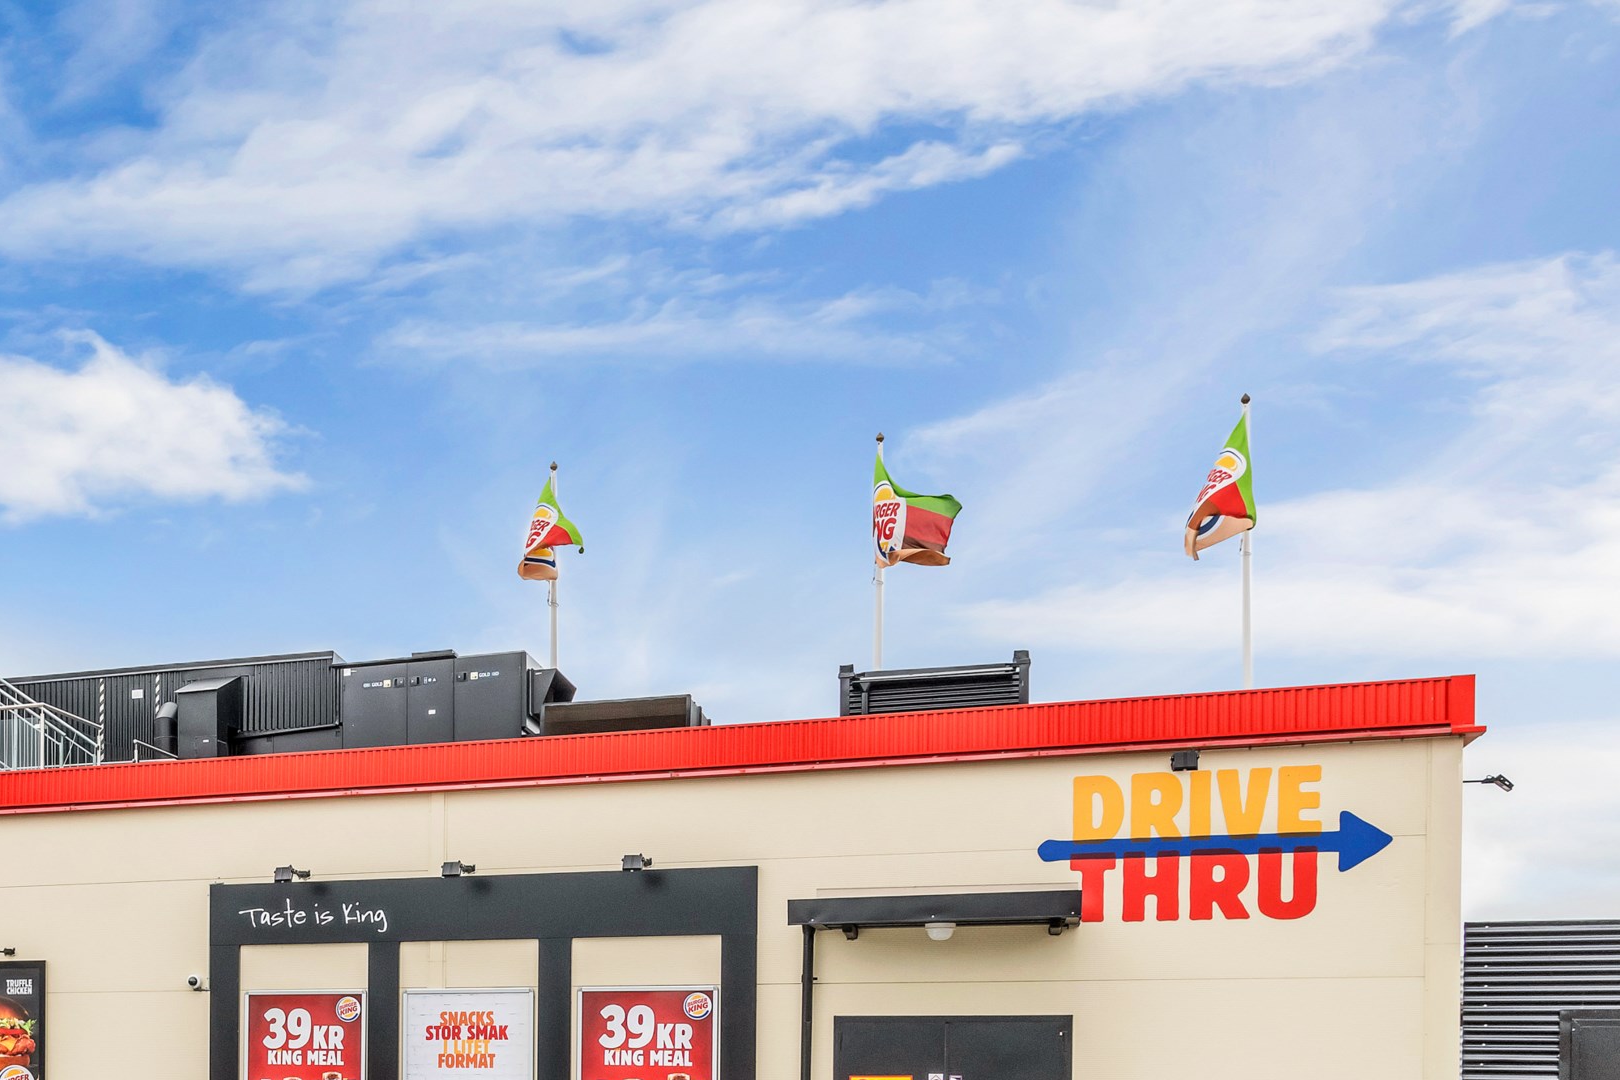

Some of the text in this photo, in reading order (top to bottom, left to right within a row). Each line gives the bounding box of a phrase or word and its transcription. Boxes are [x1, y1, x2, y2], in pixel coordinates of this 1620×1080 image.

[876, 502, 900, 518] RGER
[875, 518, 896, 540] NG
[1072, 765, 1322, 844] DRIVE
[1070, 846, 1318, 922] THRU
[238, 898, 388, 933] Taste is King
[6, 979, 32, 987] TRUFFLE
[6, 987, 32, 995] CHICKEN
[340, 1006, 358, 1015] KING
[688, 1002, 708, 1013] KING
[440, 1011, 495, 1026] SNACKS
[598, 1004, 693, 1049] 39 KR
[262, 1007, 344, 1050] 39 KR
[425, 1025, 508, 1041] STOR SMAK
[453, 1040, 491, 1054] LITET
[268, 1050, 344, 1066] KING MEAL
[437, 1053, 496, 1068] FORMAT
[604, 1050, 693, 1067] KING MEAL
